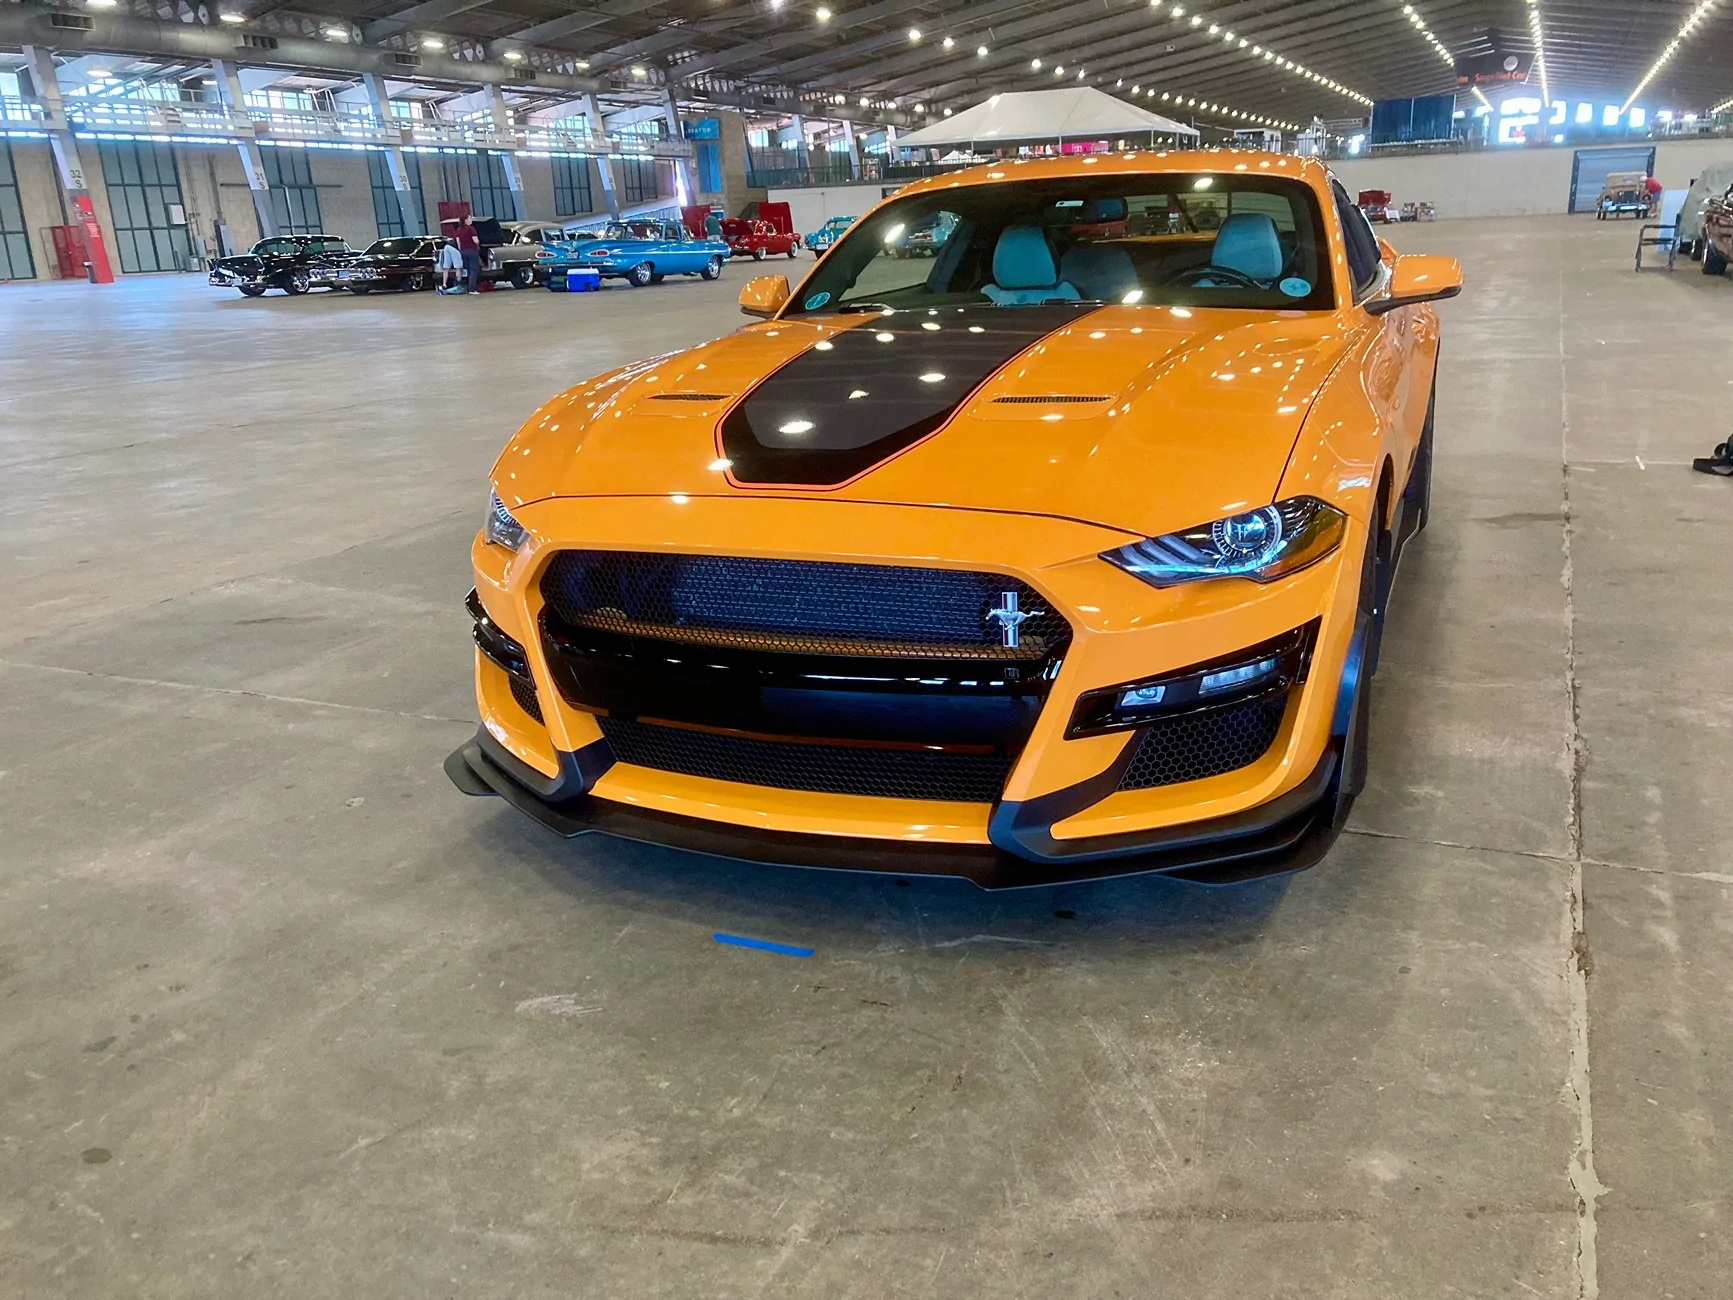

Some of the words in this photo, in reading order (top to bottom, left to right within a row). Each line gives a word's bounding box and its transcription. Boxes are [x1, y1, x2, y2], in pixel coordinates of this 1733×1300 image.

[70, 169, 82, 178] 32
[255, 172, 264, 181] 31
[75, 179, 83, 189] S
[259, 181, 266, 190] S
